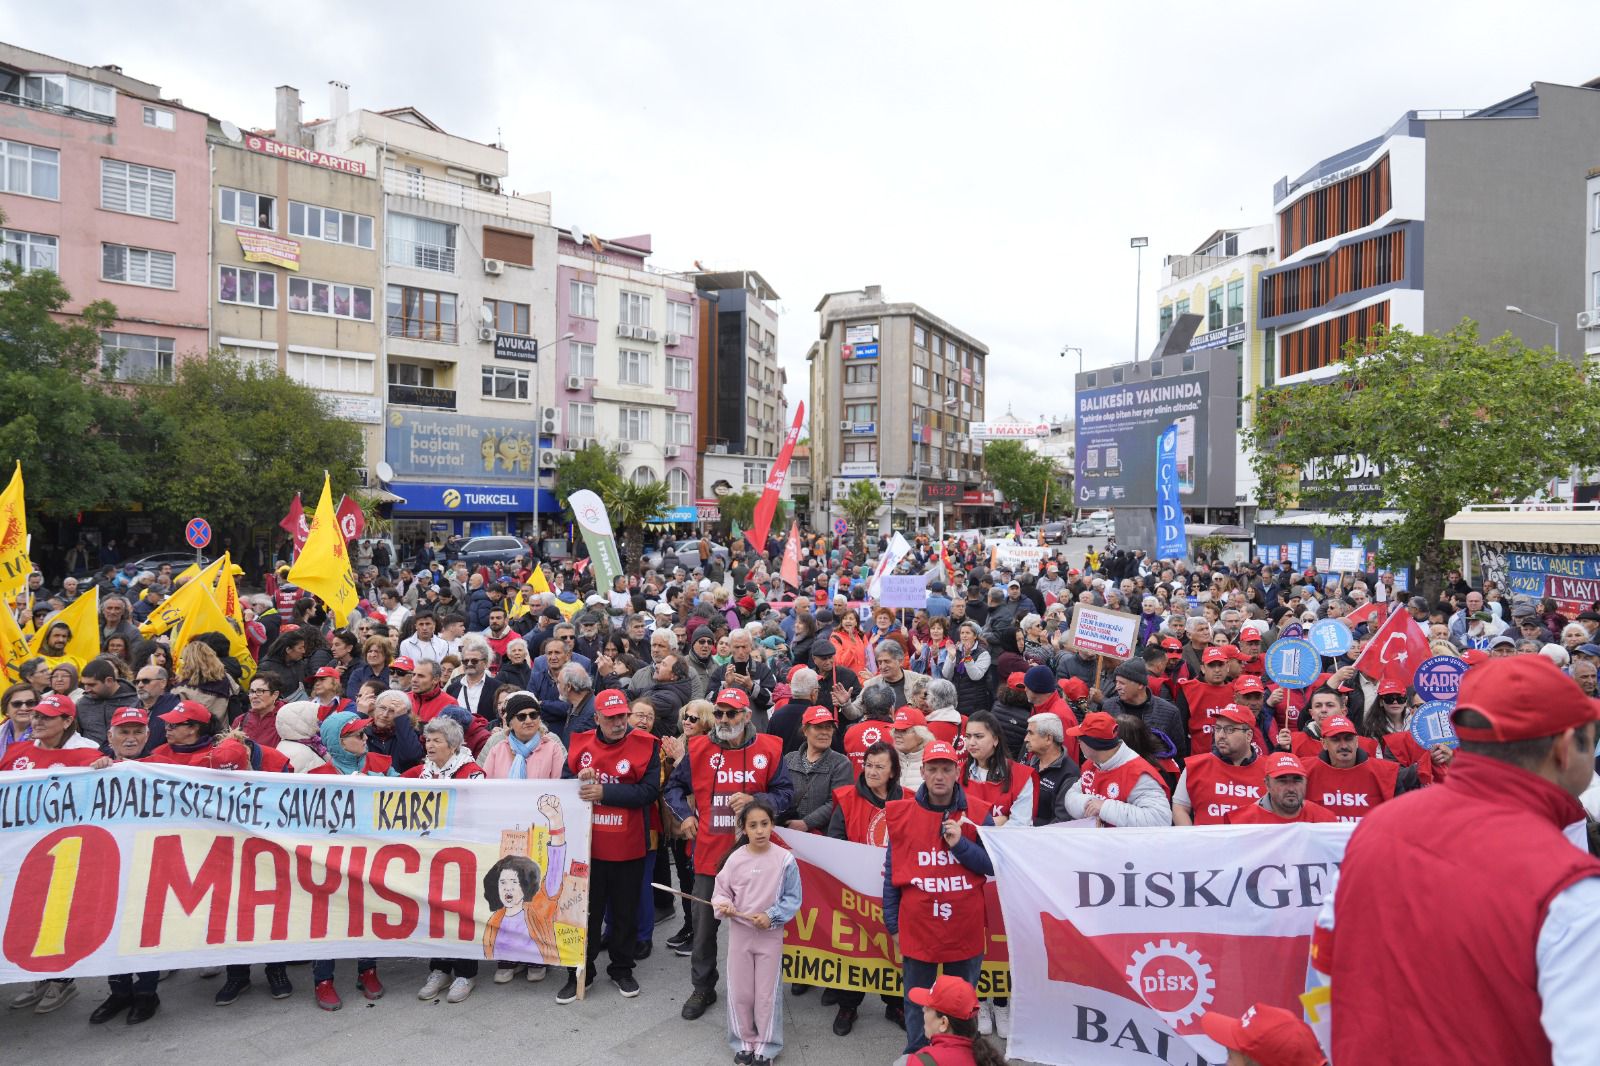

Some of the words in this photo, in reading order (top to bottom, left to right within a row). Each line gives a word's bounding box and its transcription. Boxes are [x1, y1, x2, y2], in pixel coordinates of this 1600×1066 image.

[265, 142, 305, 160] EMEK
[310, 152, 363, 173] PARTİSİ
[497, 336, 536, 351] AVUKAT
[1080, 389, 1134, 412] BALIKESİR
[1136, 382, 1202, 404] YAKININDA
[996, 427, 1034, 435] MAYIS
[410, 436, 460, 452] bağlan
[410, 453, 465, 468] hayata!
[464, 493, 519, 505] TURKCELL
[928, 485, 957, 496] 16:22
[1515, 555, 1545, 571] EMEK
[1550, 559, 1585, 576] ADALET
[1562, 579, 1600, 600] MAYI
[595, 769, 620, 784] İSK
[717, 768, 756, 783] DİSK
[1215, 781, 1260, 799] DİSK
[1323, 790, 1369, 807] DİSK
[0, 776, 83, 829] LLUĞA,
[90, 777, 270, 829] ADALETSİZLİĞE,
[277, 787, 355, 834] SAVAŞA
[377, 790, 442, 837] KARŞI
[713, 816, 736, 827] BURH
[917, 847, 961, 866] DİSK
[140, 834, 477, 948] MAYISA
[910, 875, 973, 893] GENEL
[1073, 861, 1342, 911] DİSK/GE
[933, 900, 953, 921] İŞ
[782, 951, 842, 984] RİMCİ
[848, 966, 904, 992] EMEK
[1143, 968, 1195, 993] DİSK
